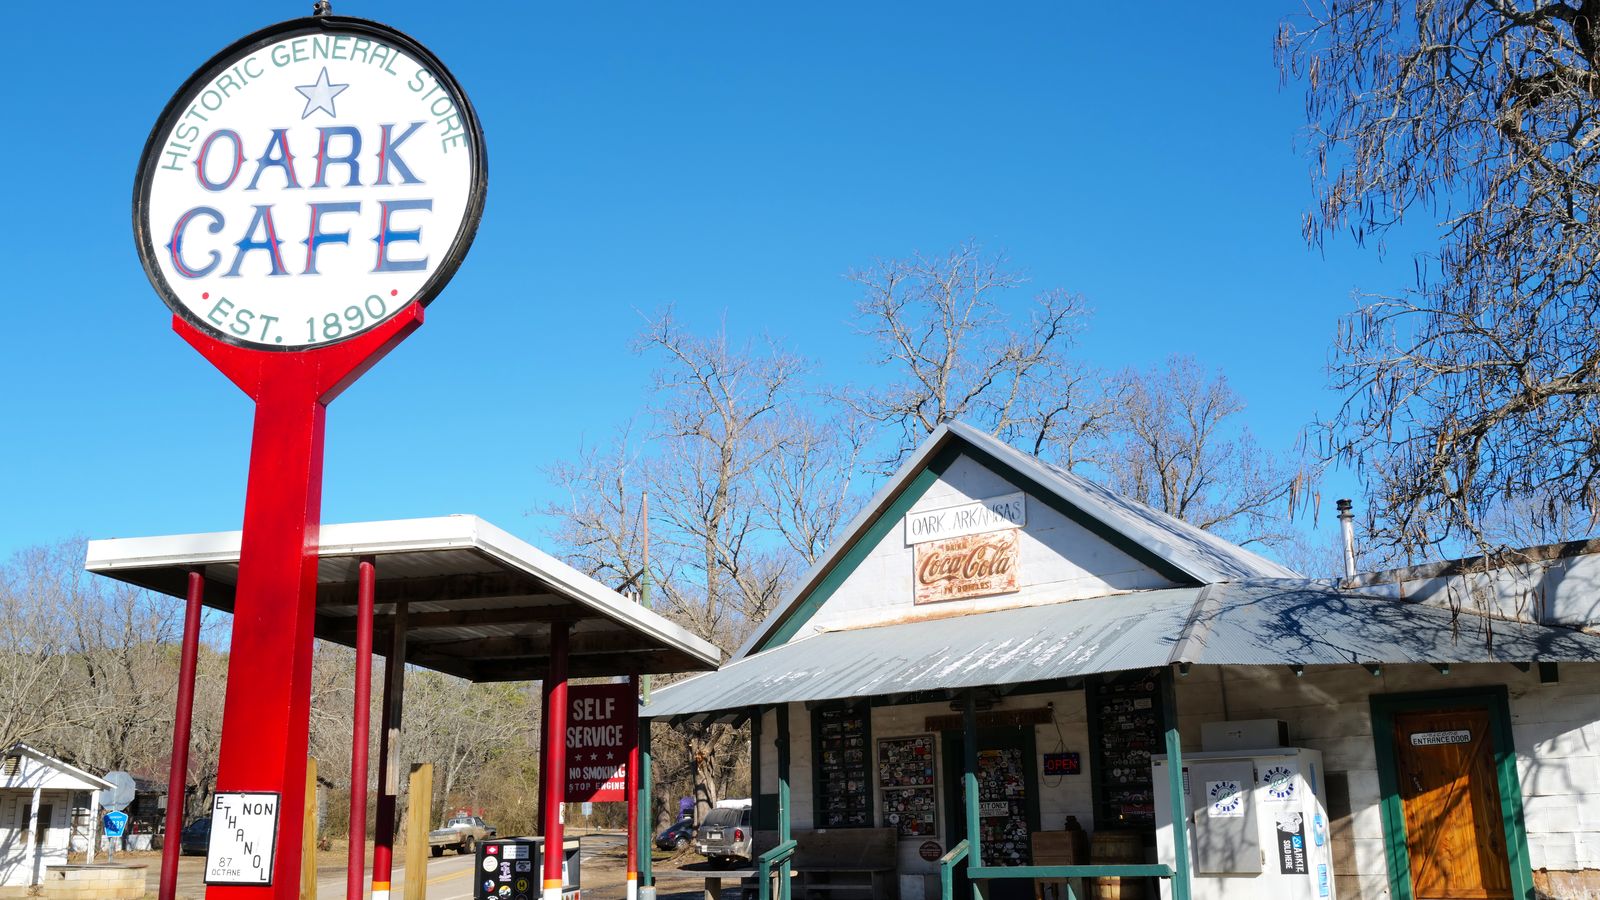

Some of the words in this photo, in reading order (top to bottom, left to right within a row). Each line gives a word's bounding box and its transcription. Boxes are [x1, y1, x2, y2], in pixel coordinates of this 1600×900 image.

[161, 57, 265, 171] HISTORIC
[270, 35, 401, 76] GENERAL
[407, 67, 468, 154] STORE
[193, 121, 427, 192] OARK
[166, 199, 433, 279] CAFE
[207, 297, 283, 343] EST.
[306, 294, 387, 342] 1890
[953, 501, 1020, 531] ARKANSAS
[572, 697, 615, 720] SELF
[566, 725, 624, 748] SERVICE
[1412, 735, 1450, 745] ENTRANCE
[1451, 734, 1469, 743] DOOR
[569, 767, 581, 780] NO
[583, 763, 626, 780] SMOKING
[1047, 758, 1078, 770] OPEN
[1263, 766, 1291, 782] BLUE
[568, 782, 591, 791] STOP
[595, 781, 625, 790] ENGINE
[1210, 781, 1237, 797] BLUE
[1269, 783, 1294, 798] CHIP
[242, 803, 273, 816] NON
[1283, 839, 1291, 854] SOLD
[218, 857, 232, 868] 87
[1284, 854, 1293, 869] HERE
[211, 868, 241, 876] OCTANE
